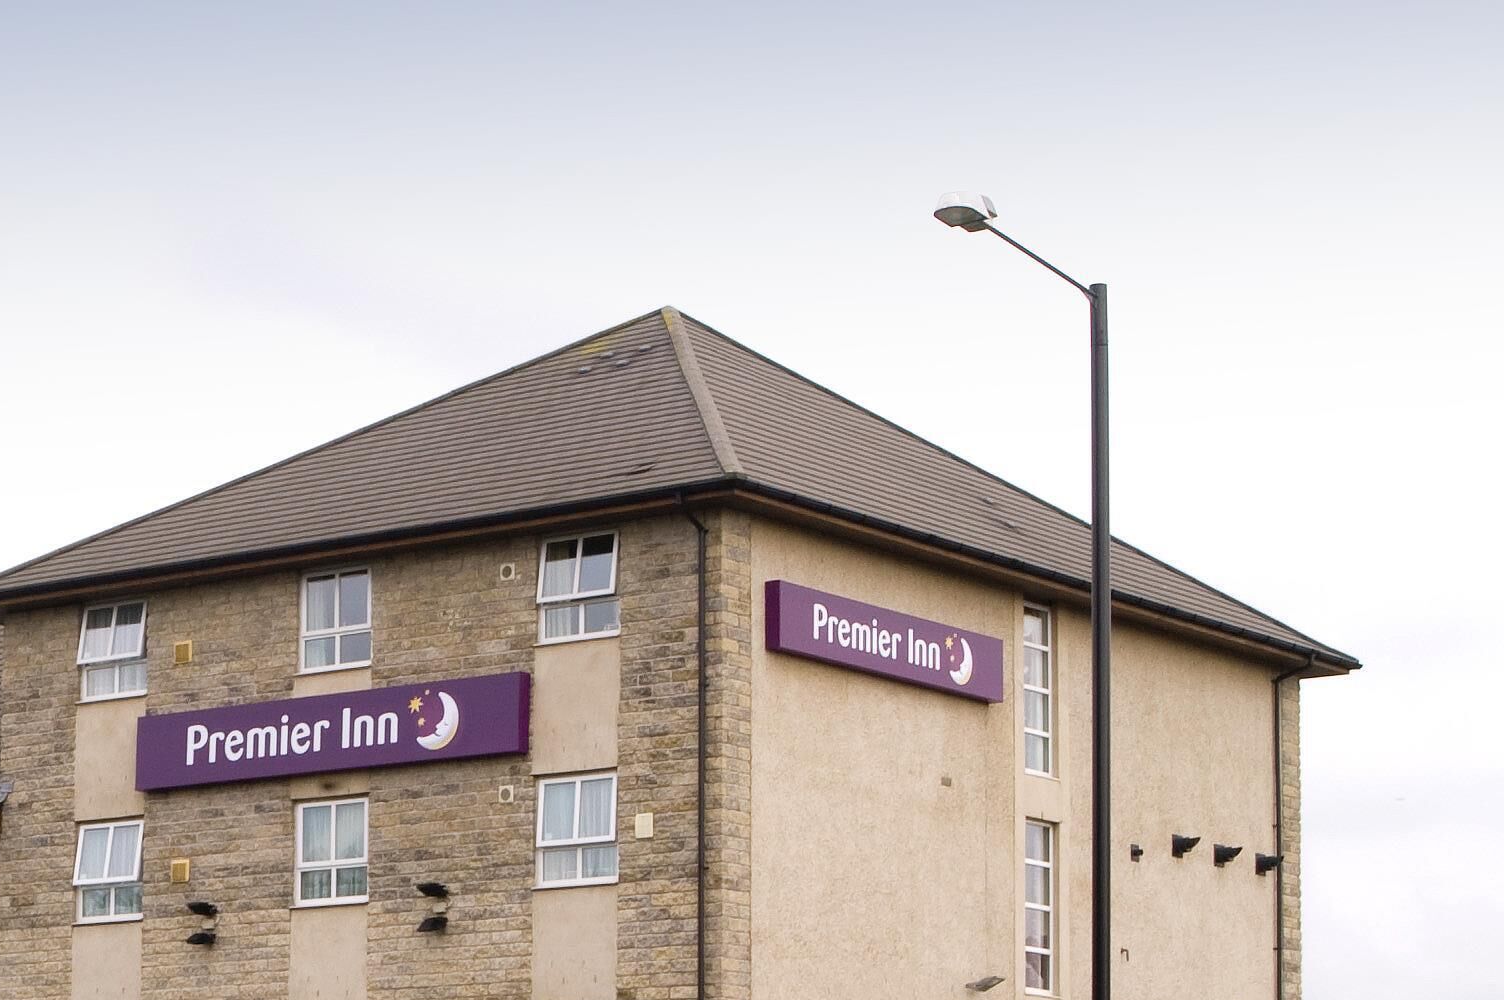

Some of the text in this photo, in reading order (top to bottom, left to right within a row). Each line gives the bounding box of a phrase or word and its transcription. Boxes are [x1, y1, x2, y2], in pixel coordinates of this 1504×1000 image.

[813, 603, 941, 671] Premier Inn
[186, 708, 399, 766] Premier Inn
